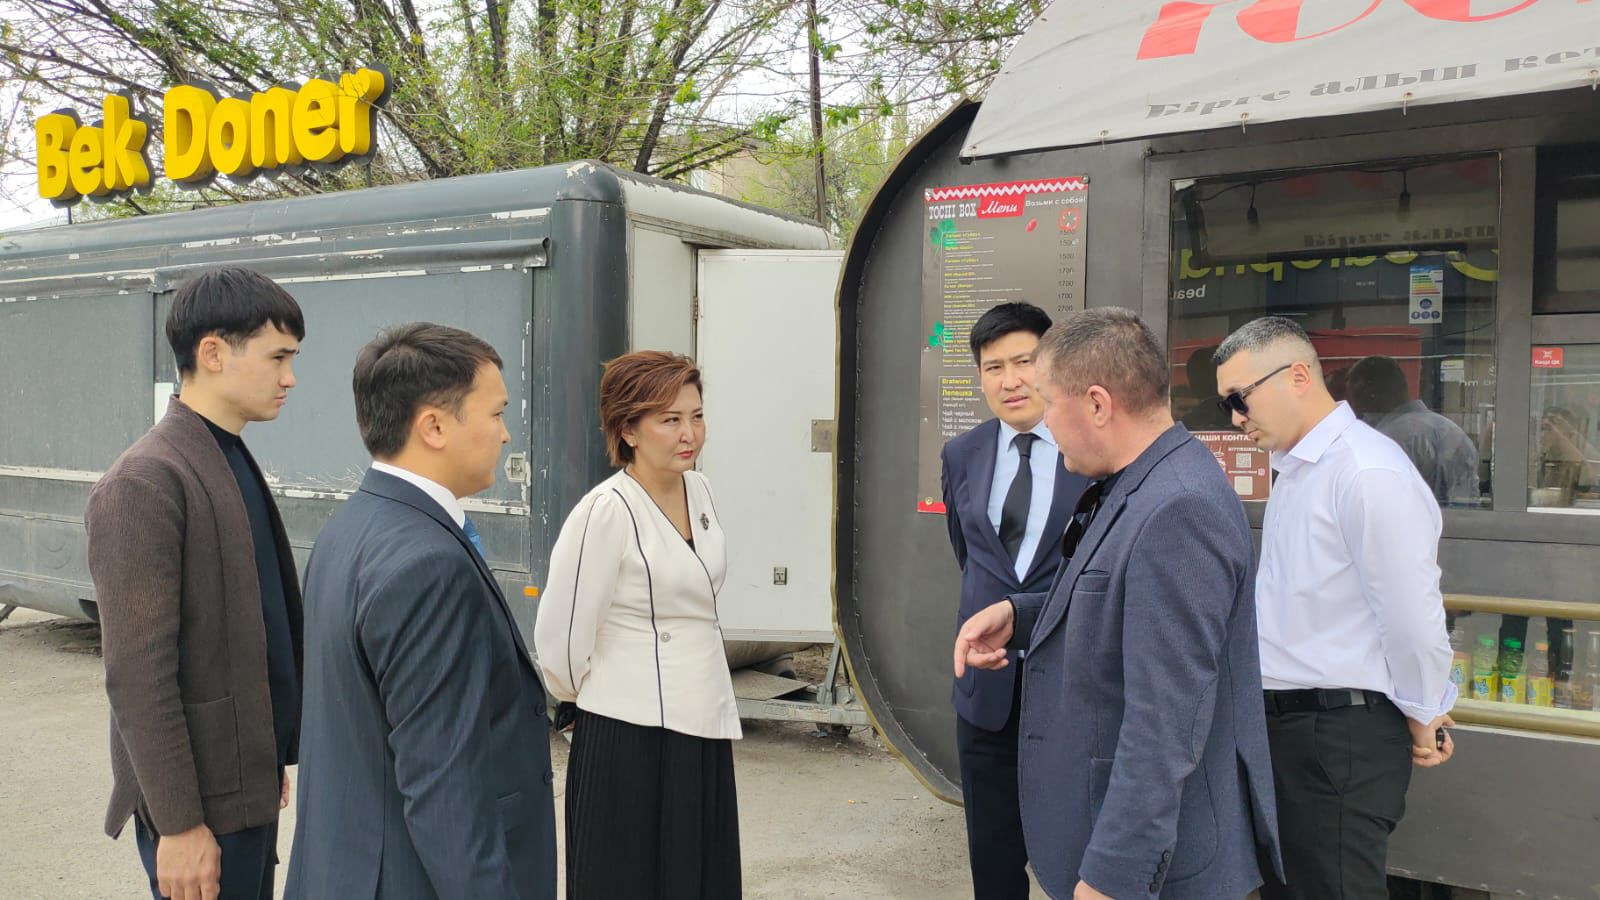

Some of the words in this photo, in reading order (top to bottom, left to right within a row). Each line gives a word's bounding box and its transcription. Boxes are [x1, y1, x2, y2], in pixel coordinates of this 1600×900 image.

[1310, 63, 1479, 97] алып
[35, 94, 151, 199] Bek
[164, 67, 385, 182] Doner
[929, 204, 956, 219] TOCHI
[959, 203, 976, 216] BOX
[981, 201, 1018, 215] Menu
[1026, 199, 1053, 207] Возьми
